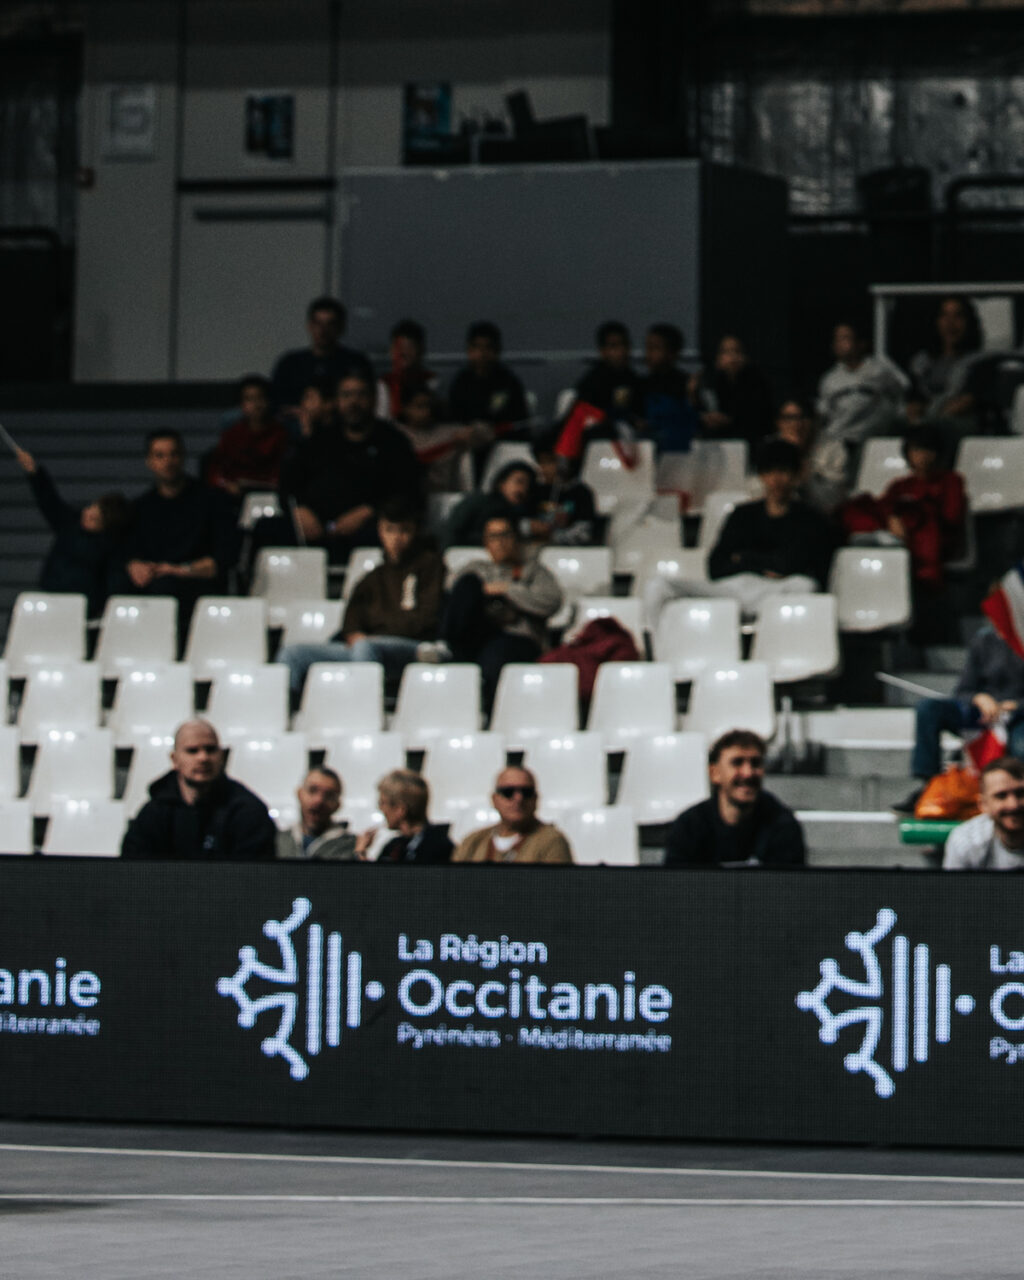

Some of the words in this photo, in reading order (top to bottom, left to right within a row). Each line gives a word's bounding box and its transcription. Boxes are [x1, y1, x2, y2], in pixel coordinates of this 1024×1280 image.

[398, 933, 433, 961] La
[440, 933, 548, 969] Région
[397, 968, 673, 1022] Occitanie
[397, 1022, 501, 1049] Pyrénées
[519, 1025, 673, 1052] Méditerranée
